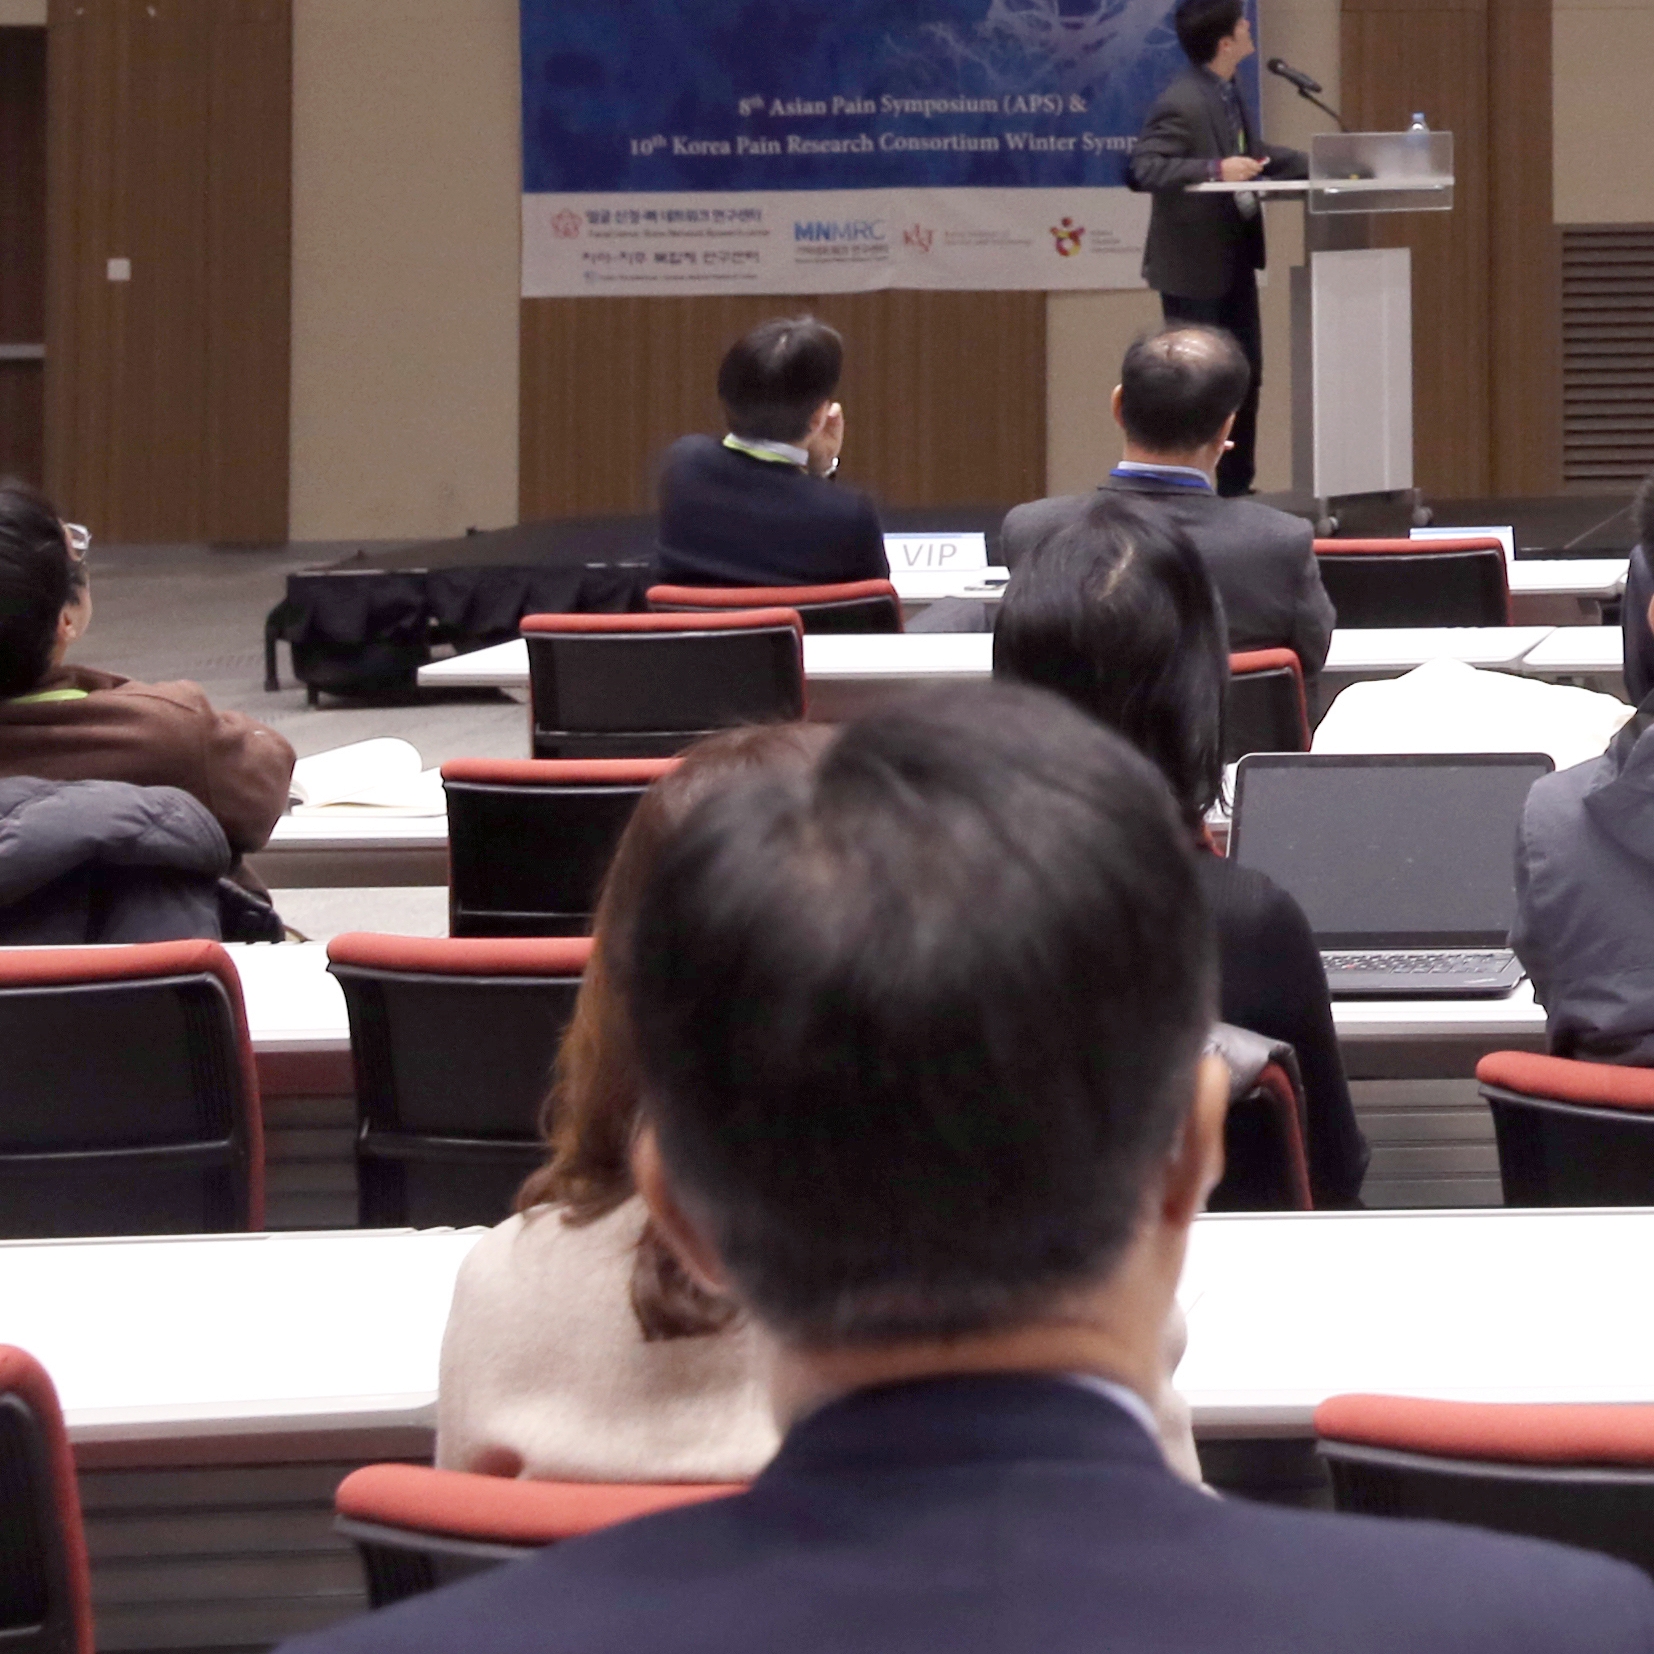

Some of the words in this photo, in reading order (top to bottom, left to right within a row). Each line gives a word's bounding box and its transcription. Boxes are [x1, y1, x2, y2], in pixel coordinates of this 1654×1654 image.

[739, 96, 765, 117] 8th
[769, 95, 826, 117] Asian
[831, 93, 876, 116] Pain
[880, 94, 998, 120] Symposium
[1003, 93, 1064, 117] (APS)
[1069, 94, 1088, 114] &
[630, 135, 668, 158] 10th
[672, 135, 732, 156] Korea
[737, 135, 782, 156] Pain
[788, 132, 875, 155] Research
[878, 132, 1000, 155] Consortium
[1005, 131, 1077, 153] Winter
[794, 220, 886, 242] MNMRC
[902, 542, 958, 567] VIP
